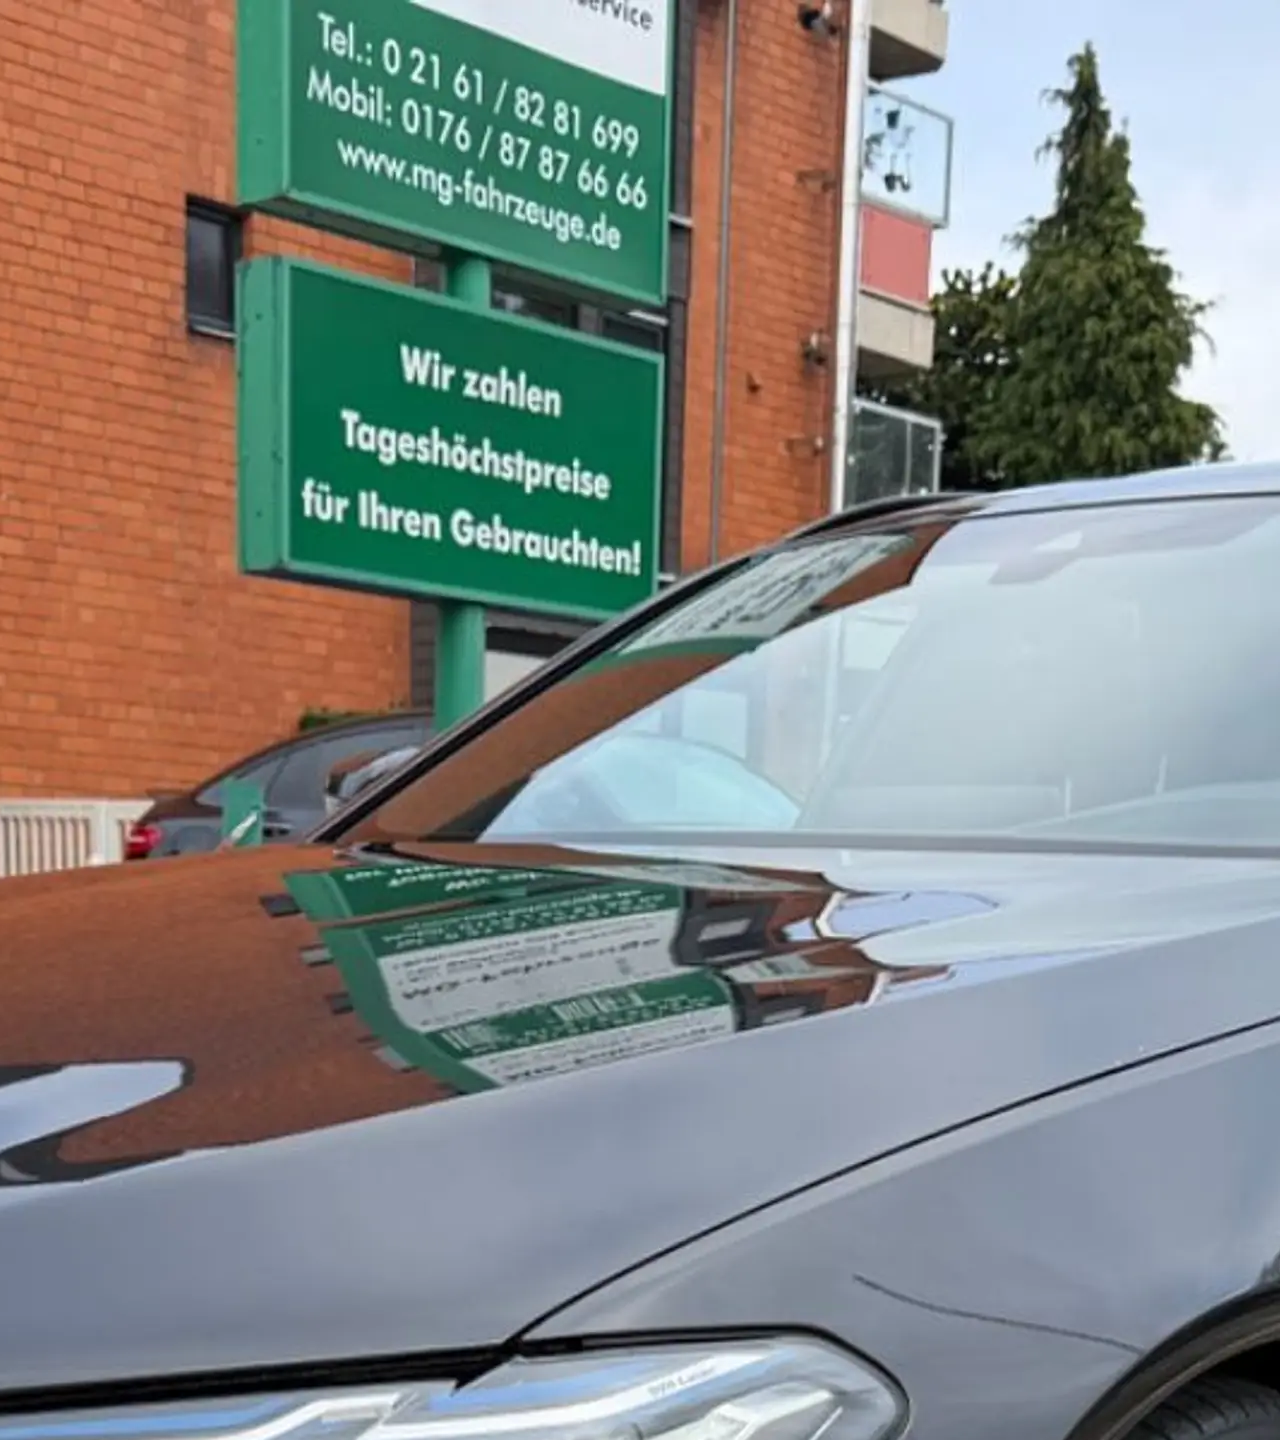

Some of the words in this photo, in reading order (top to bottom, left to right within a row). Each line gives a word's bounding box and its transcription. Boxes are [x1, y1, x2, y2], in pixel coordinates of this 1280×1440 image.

[577, 0, 653, 30] ervice
[317, 11, 373, 66] Tel.:
[382, 37, 402, 76] 0
[409, 47, 440, 91] 21
[453, 63, 483, 105] 61
[493, 79, 508, 115] /
[514, 86, 546, 128] 82
[553, 99, 580, 140] 81
[592, 114, 639, 159] 699
[306, 65, 392, 128] Mobil:
[401, 98, 471, 152] 0176
[478, 125, 493, 160] /
[499, 131, 531, 171] 87
[538, 145, 570, 183] 87
[577, 158, 610, 198] 66
[616, 171, 648, 210] 66
[337, 138, 621, 250] www.mg-fahrzeuge.de
[400, 344, 455, 392] Wir
[462, 367, 562, 418] zahlen
[341, 408, 610, 500] Tageshöchstpreise
[302, 477, 349, 523] für
[359, 490, 441, 541] Ihren
[451, 509, 641, 576] Gebrauchten!
